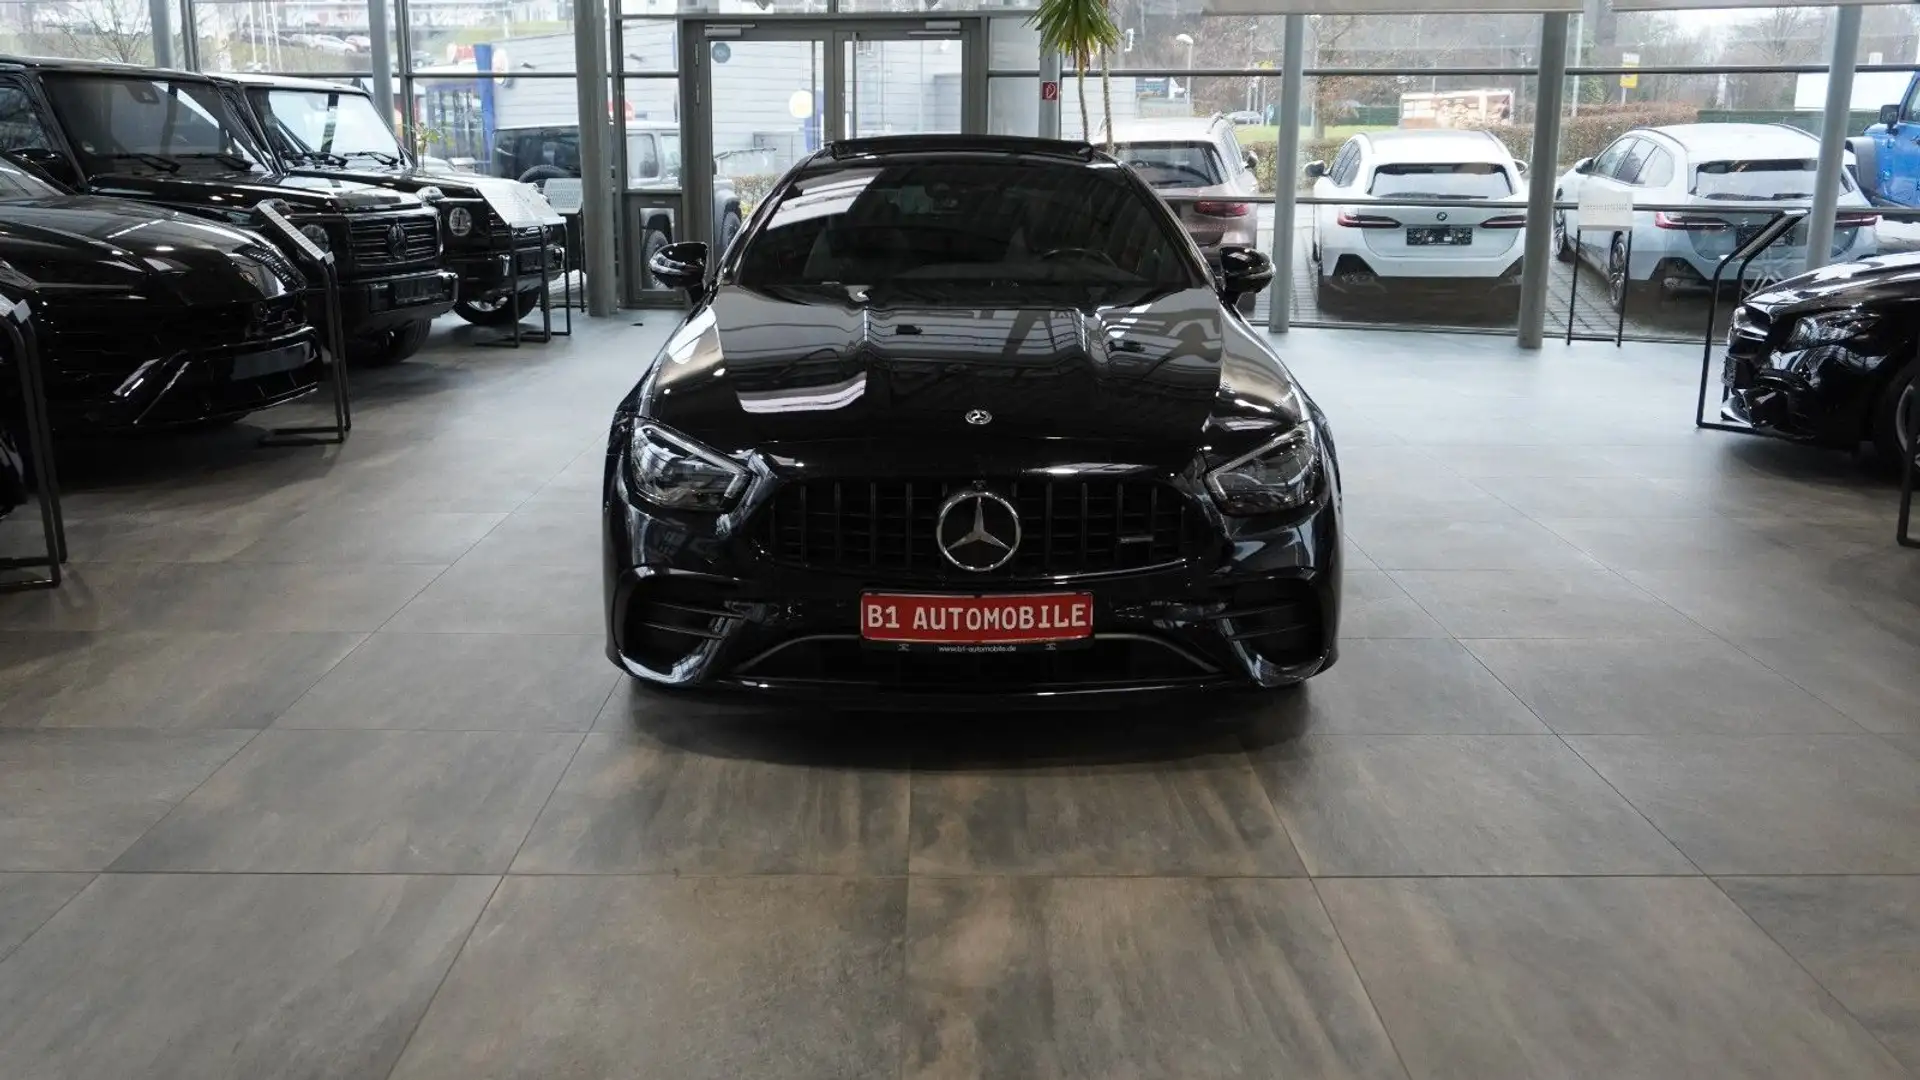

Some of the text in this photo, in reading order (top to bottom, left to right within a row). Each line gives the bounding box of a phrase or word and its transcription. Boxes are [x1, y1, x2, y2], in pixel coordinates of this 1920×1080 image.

[867, 603, 1087, 630] B1 AUTOMOBILE
[938, 645, 1017, 653] www.b1-automobile.de
